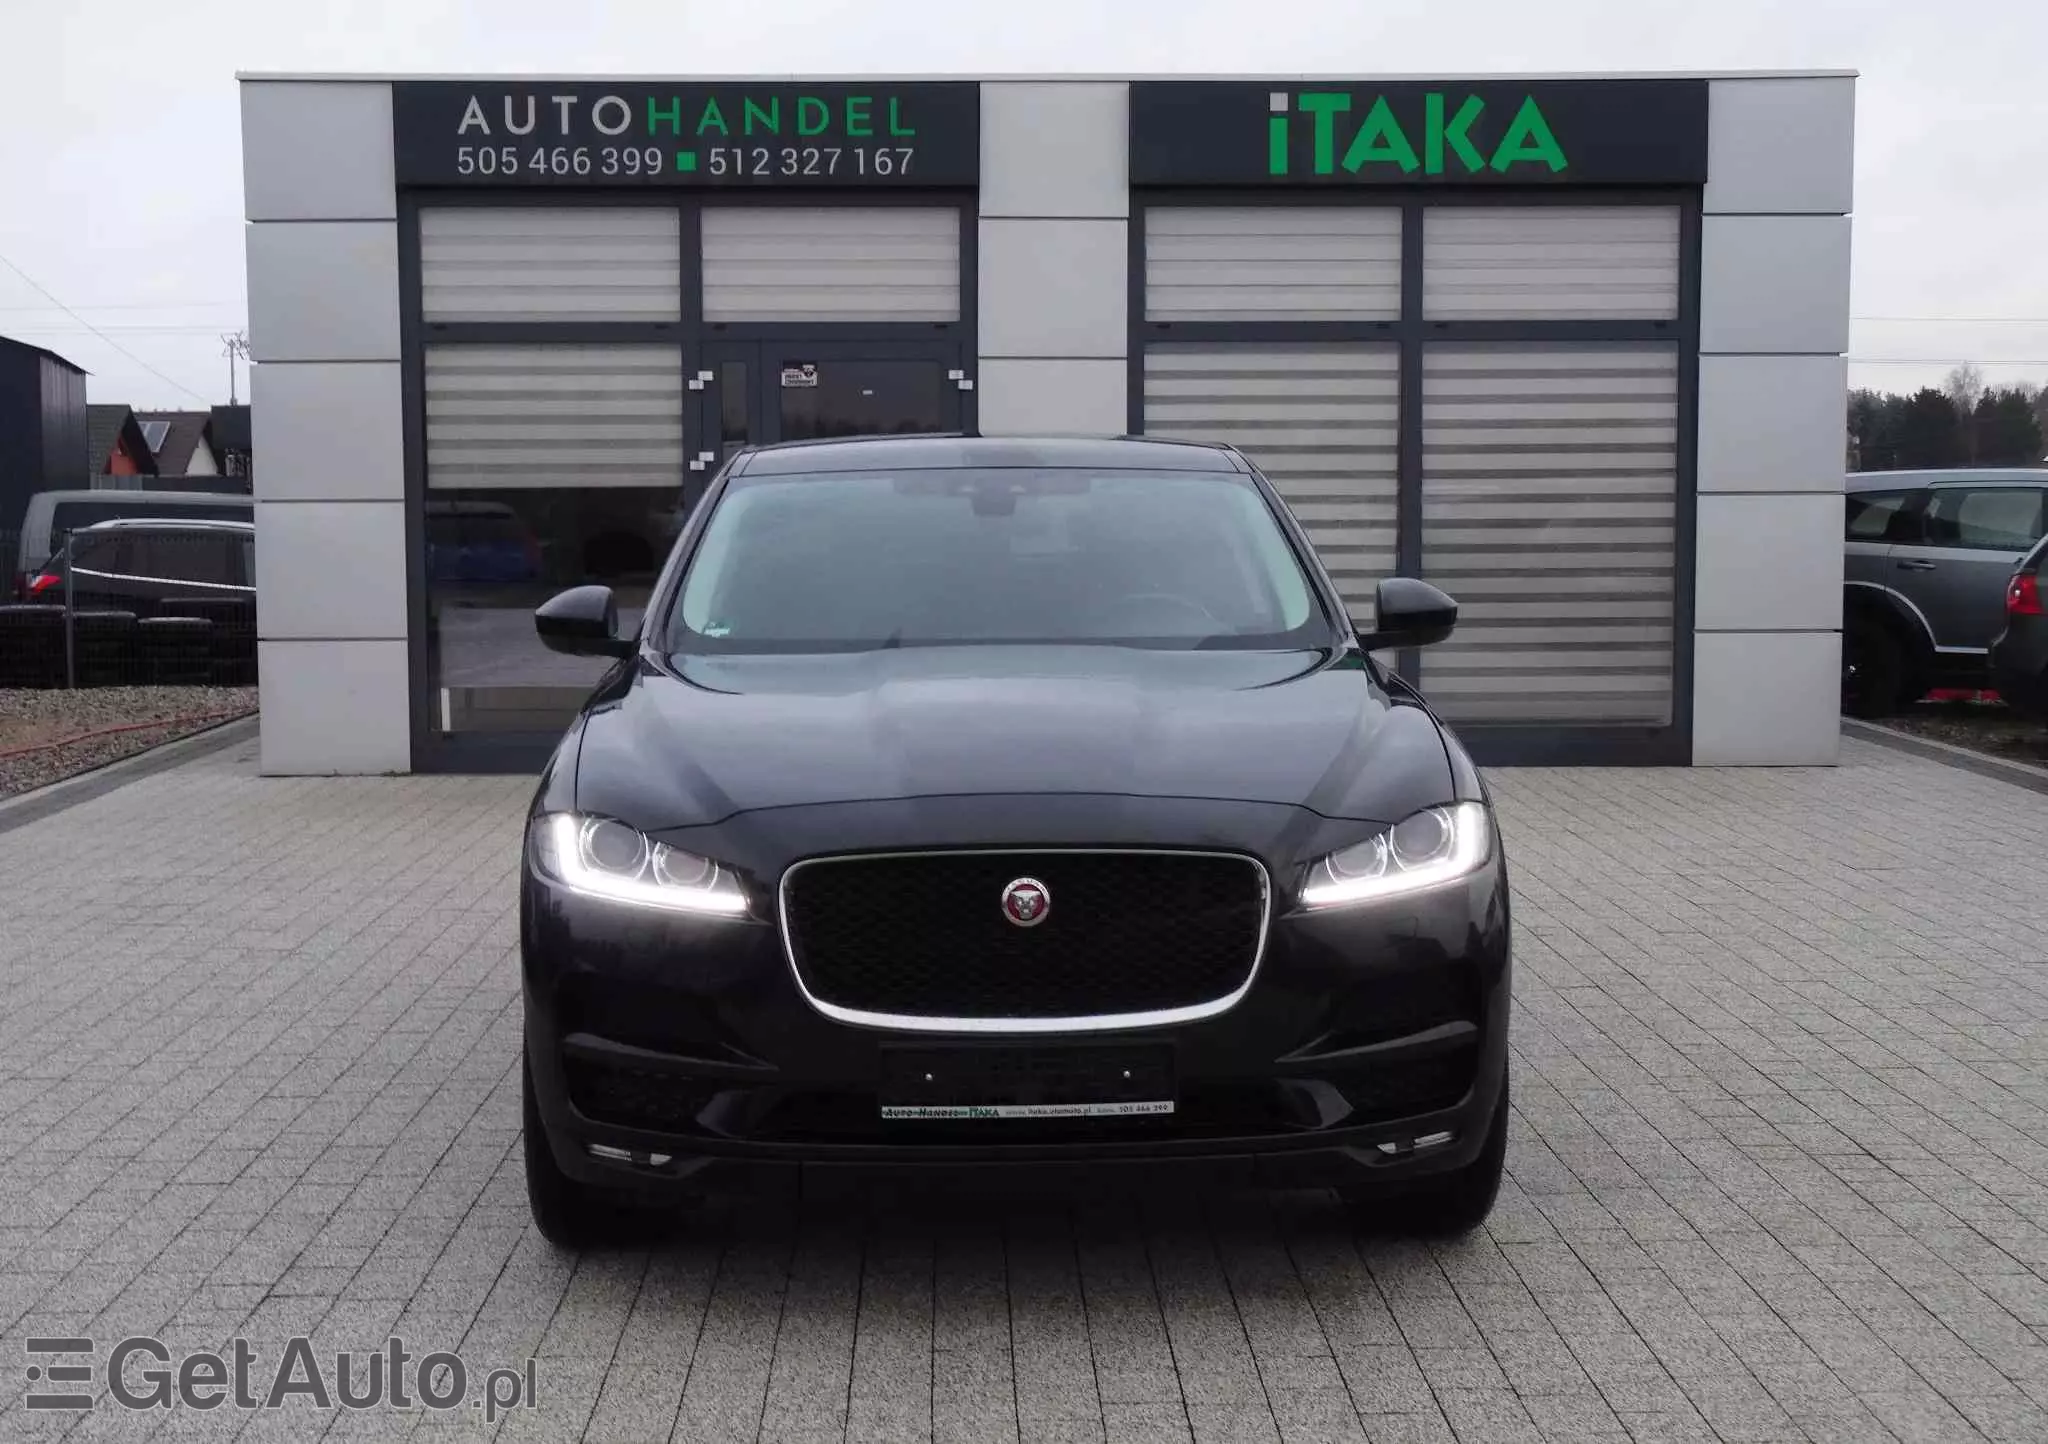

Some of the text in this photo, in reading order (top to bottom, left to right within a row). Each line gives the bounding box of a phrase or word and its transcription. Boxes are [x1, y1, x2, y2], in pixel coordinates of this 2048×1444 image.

[457, 146, 915, 176] 505 466 399 512 327 167
[1269, 92, 1569, 175] iTAKA
